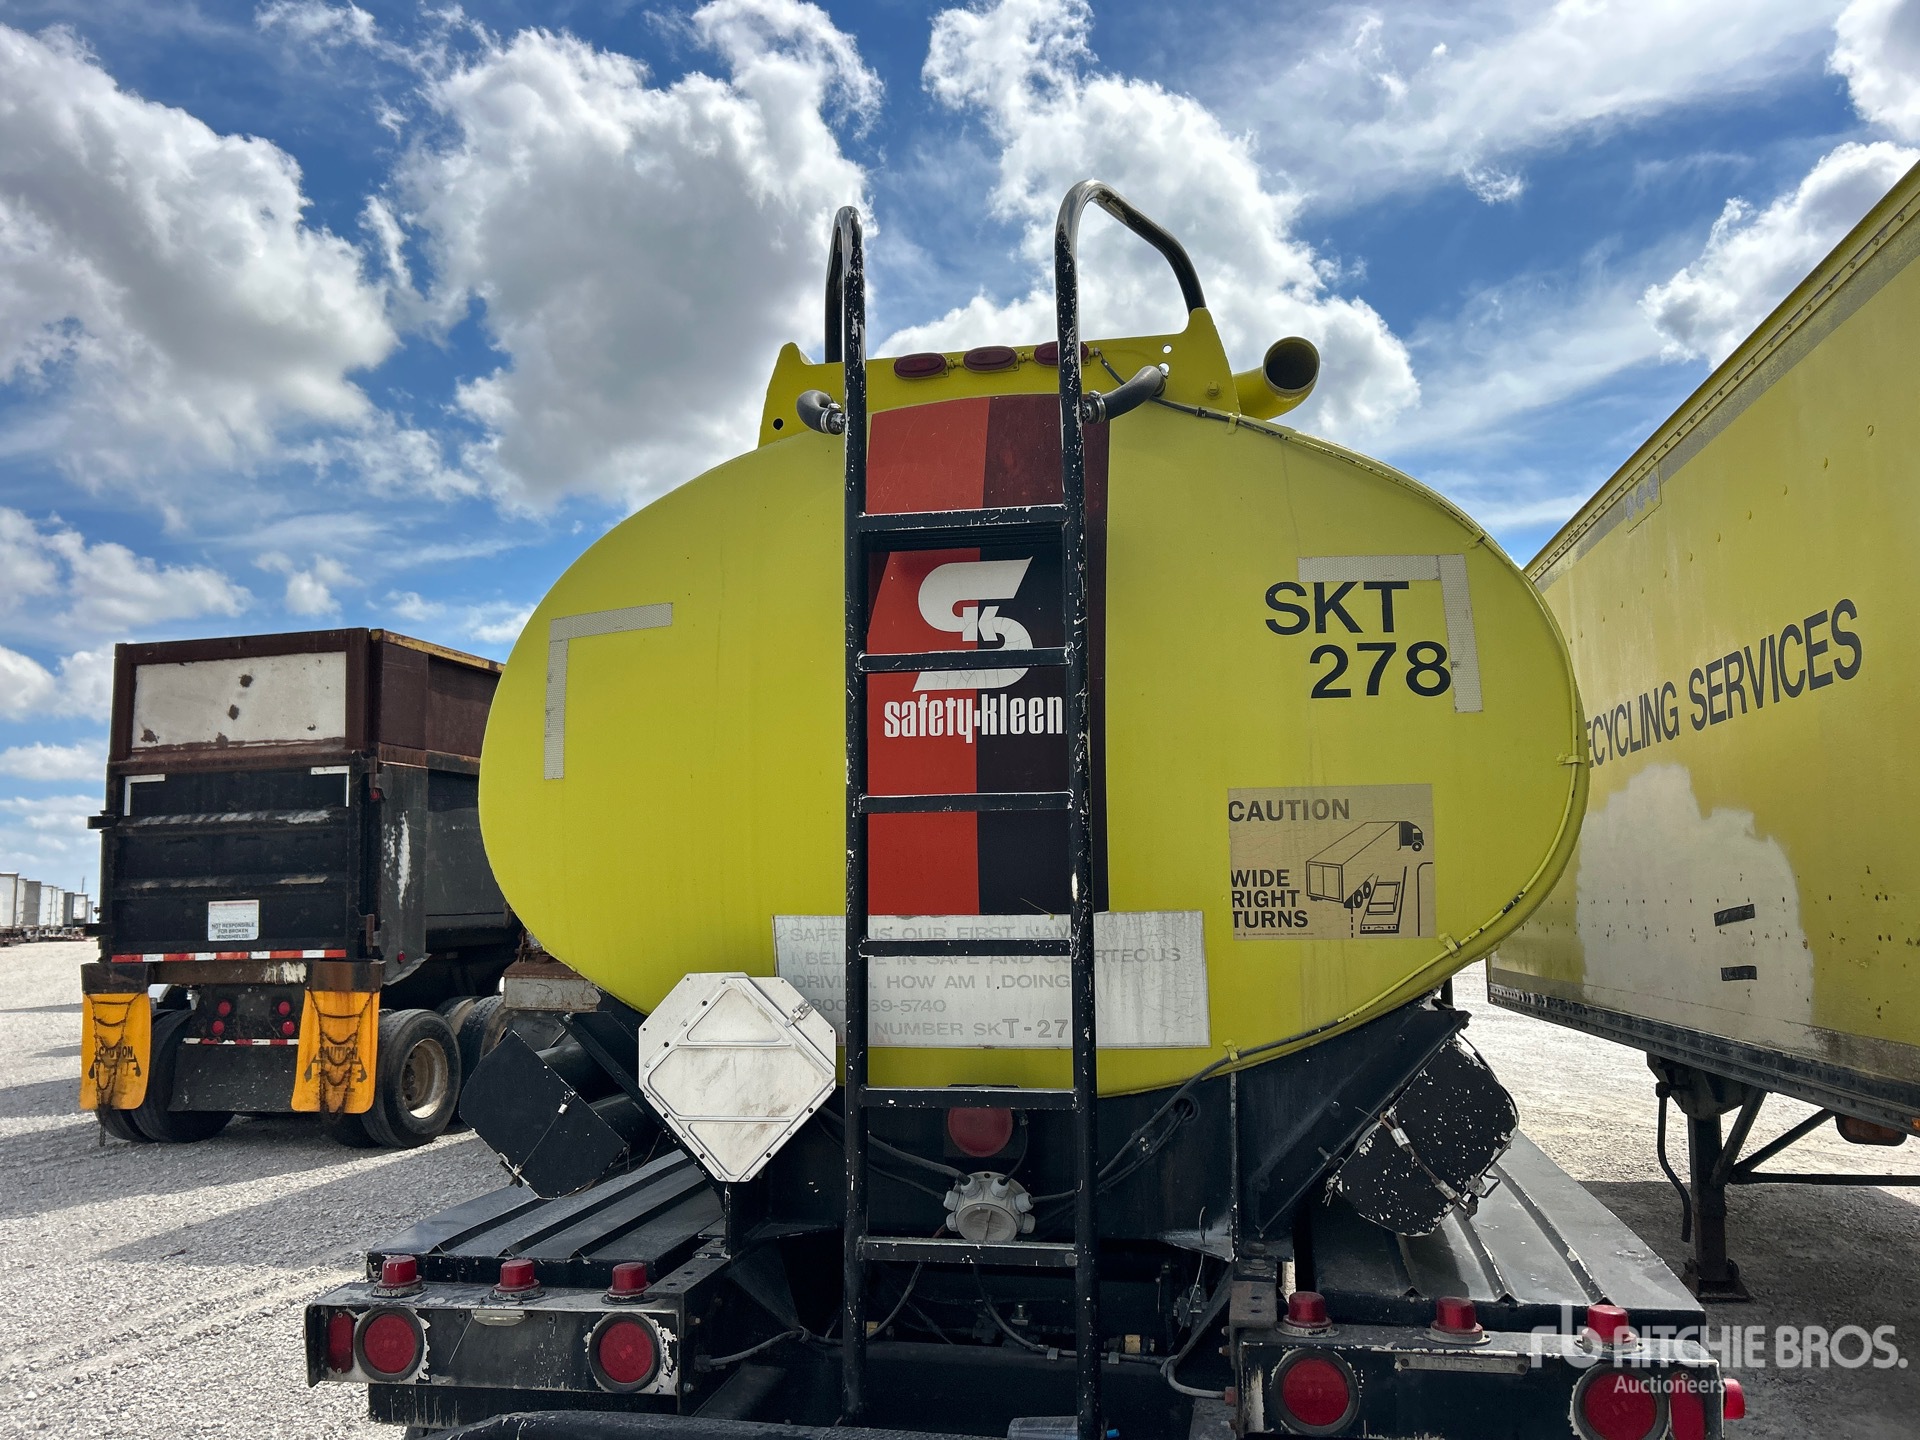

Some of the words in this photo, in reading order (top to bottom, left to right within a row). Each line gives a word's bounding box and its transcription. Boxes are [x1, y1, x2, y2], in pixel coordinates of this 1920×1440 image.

[1264, 580, 1410, 636] SKT
[1309, 641, 1452, 699] 278
[1585, 681, 1680, 769] ECYCLING
[1688, 598, 1863, 732] SERVICES
[1228, 798, 1350, 822] CAUTION
[1231, 869, 1291, 888] WIDE
[1232, 890, 1300, 908] RIGHT
[1233, 910, 1309, 928] TURNS
[956, 926, 1015, 939] FIRST
[1026, 925, 1070, 938] NAM
[887, 975, 937, 989] HOW
[944, 975, 976, 989] AM
[1001, 974, 1071, 989] DOING
[875, 1021, 964, 1036] NUMBER
